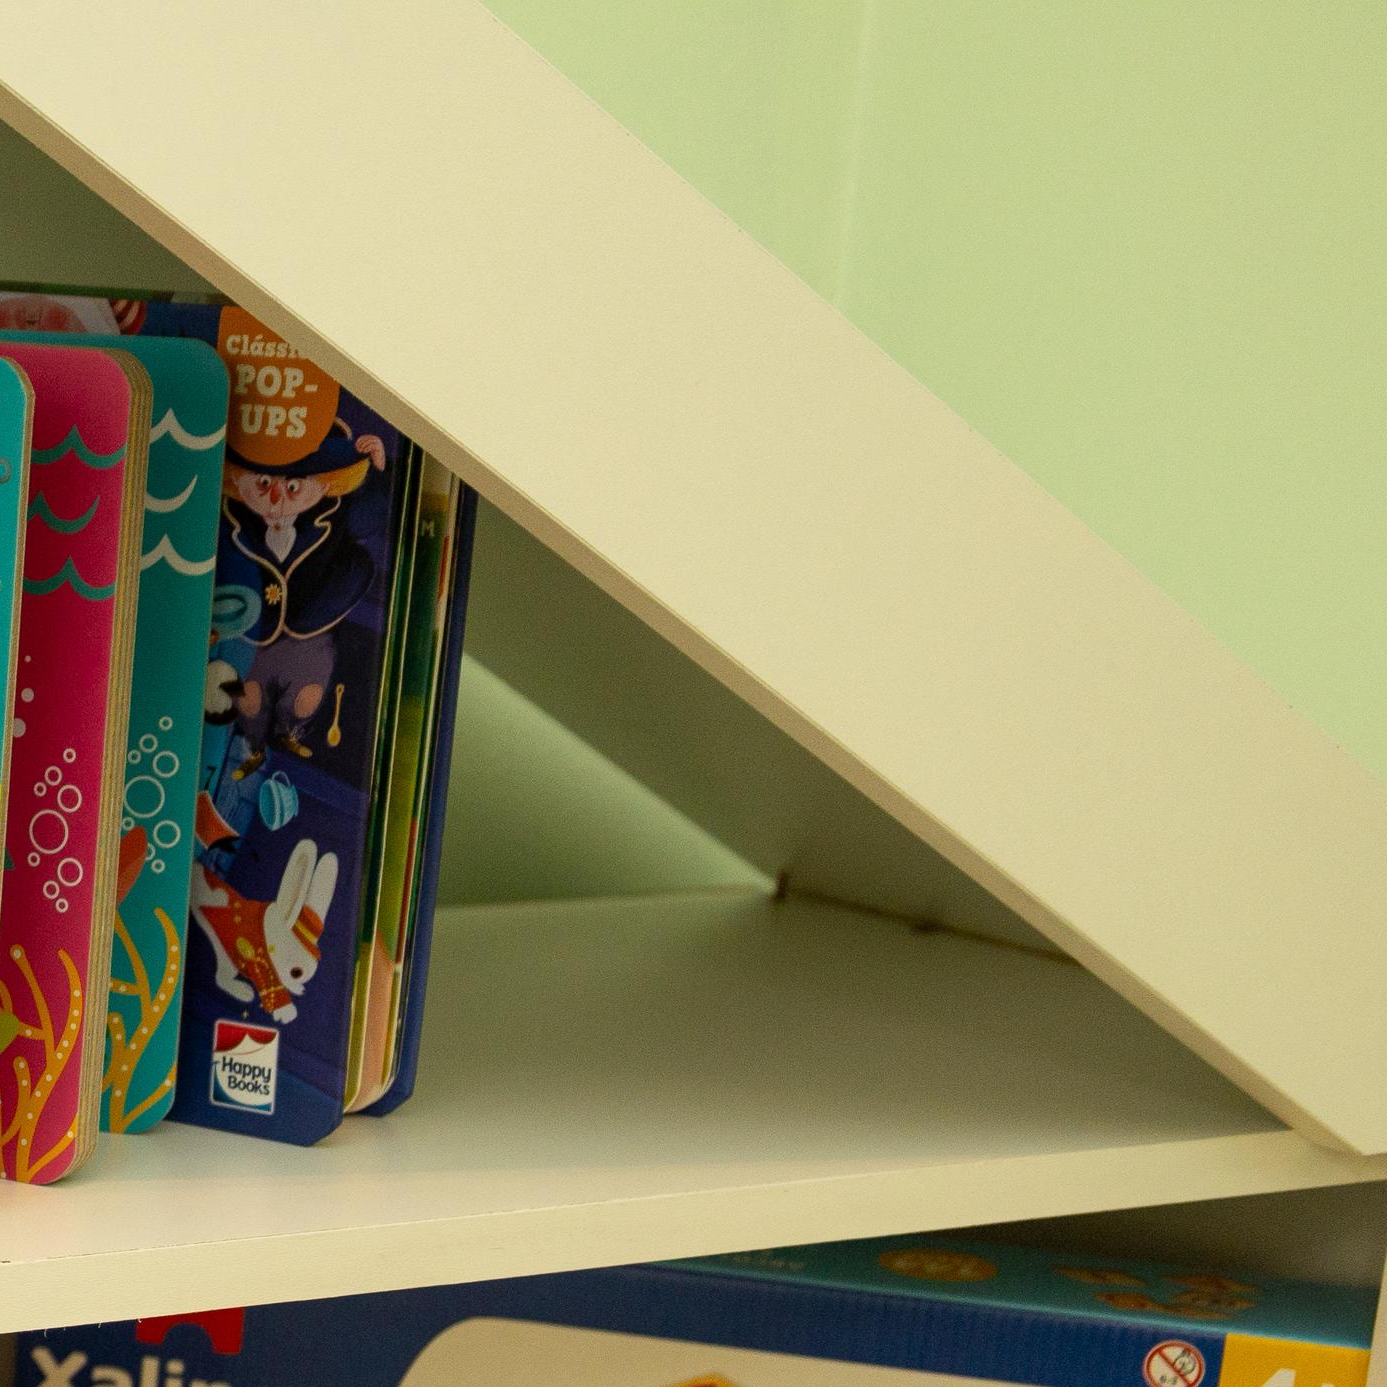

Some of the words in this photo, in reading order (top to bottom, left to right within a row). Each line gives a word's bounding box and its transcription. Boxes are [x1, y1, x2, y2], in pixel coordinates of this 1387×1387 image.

[235, 364, 319, 399] POP-
[241, 403, 308, 439] UPS
[221, 1056, 272, 1084] Happy
[227, 1074, 270, 1096] Books
